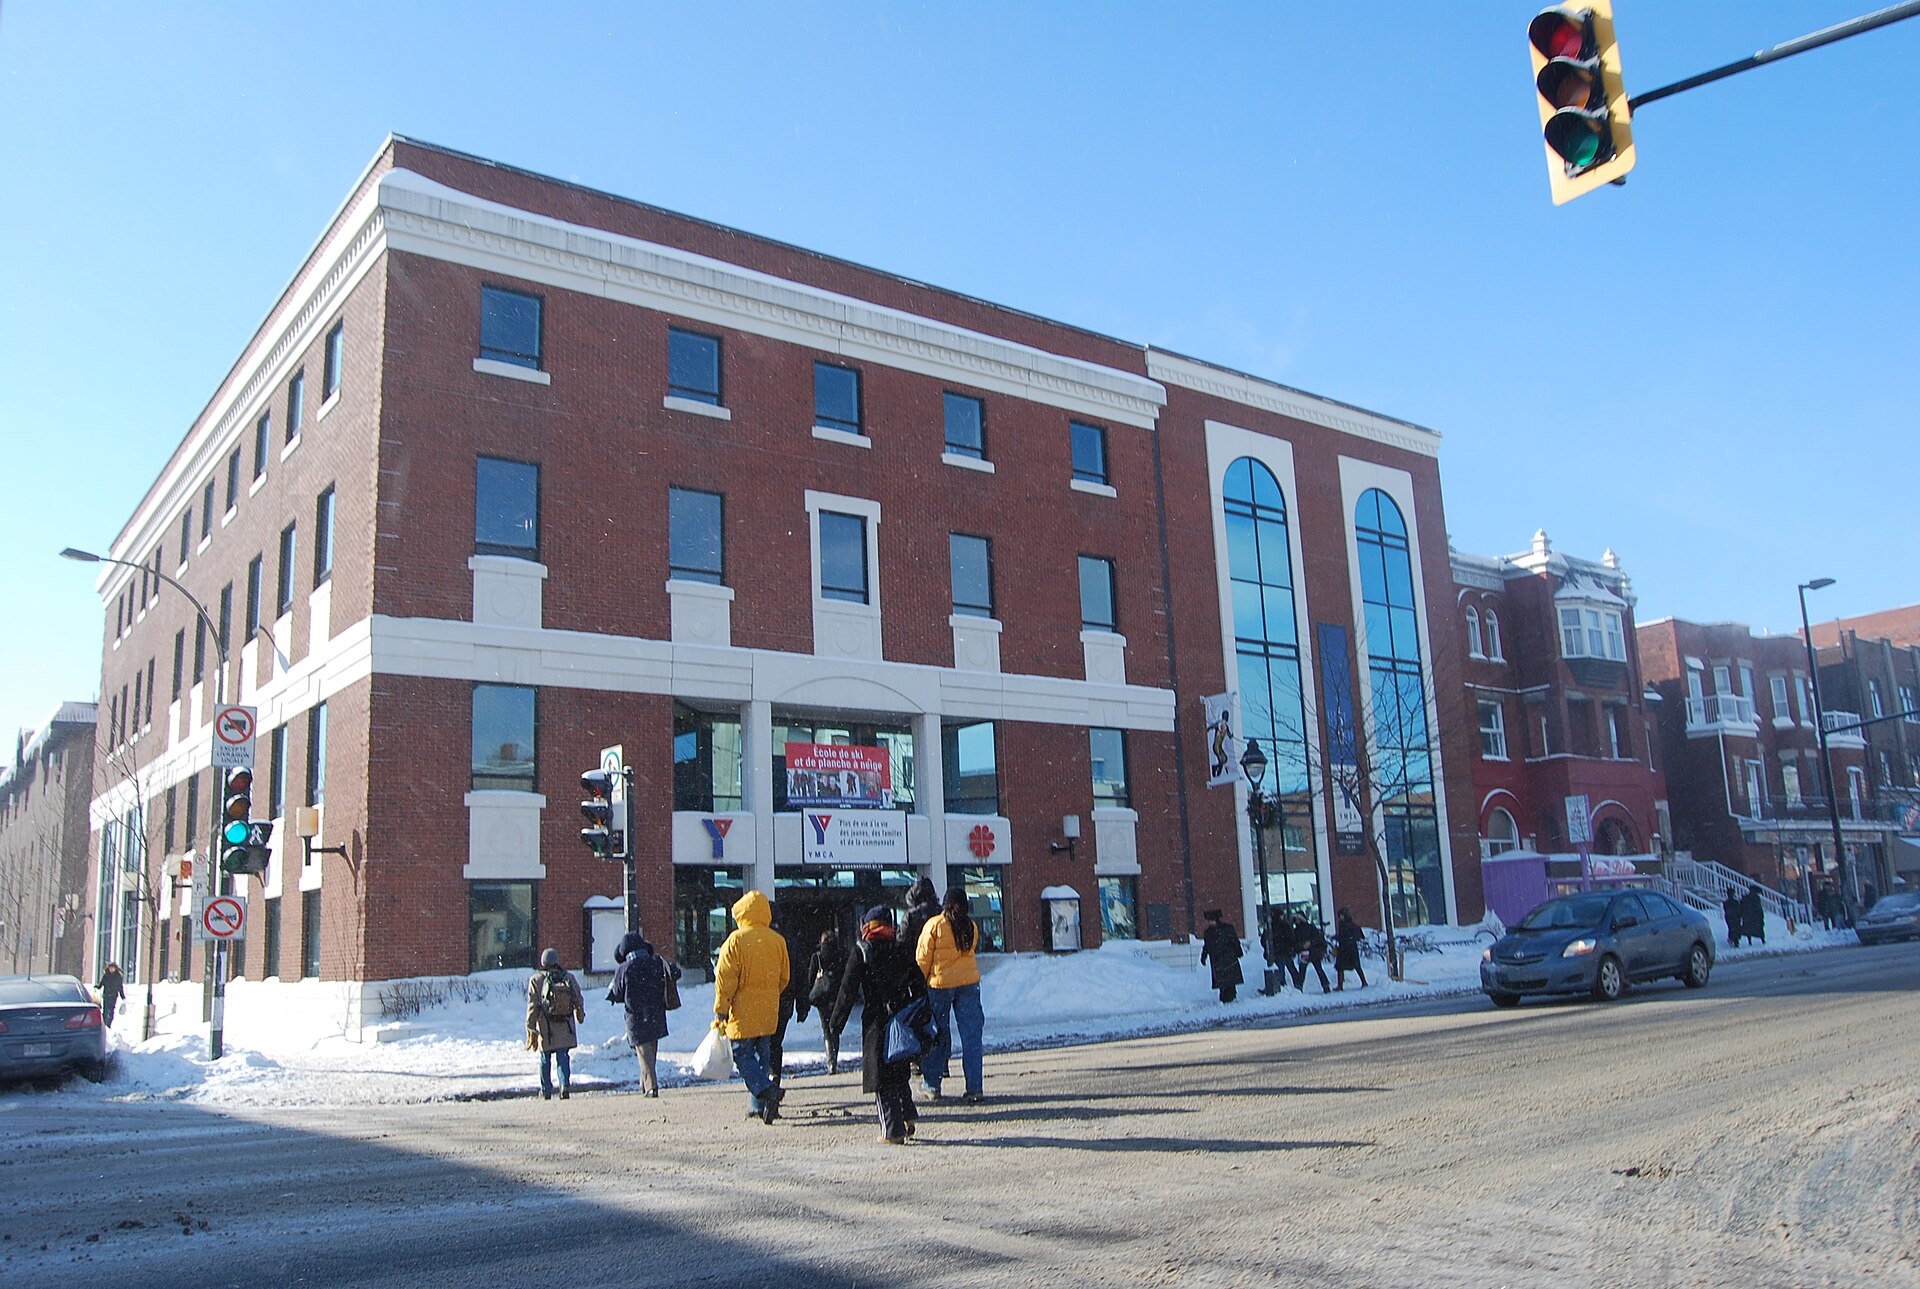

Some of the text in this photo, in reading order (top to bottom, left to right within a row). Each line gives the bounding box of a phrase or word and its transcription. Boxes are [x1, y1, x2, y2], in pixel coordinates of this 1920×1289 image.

[813, 745, 864, 760] École de ski
[794, 757, 883, 772] et de planche à neige
[852, 819, 859, 827] de
[874, 819, 880, 827] la
[881, 829, 902, 837] familles
[840, 838, 846, 846] et
[847, 838, 854, 846] de
[855, 838, 861, 846] la
[808, 851, 834, 859] YMCA
